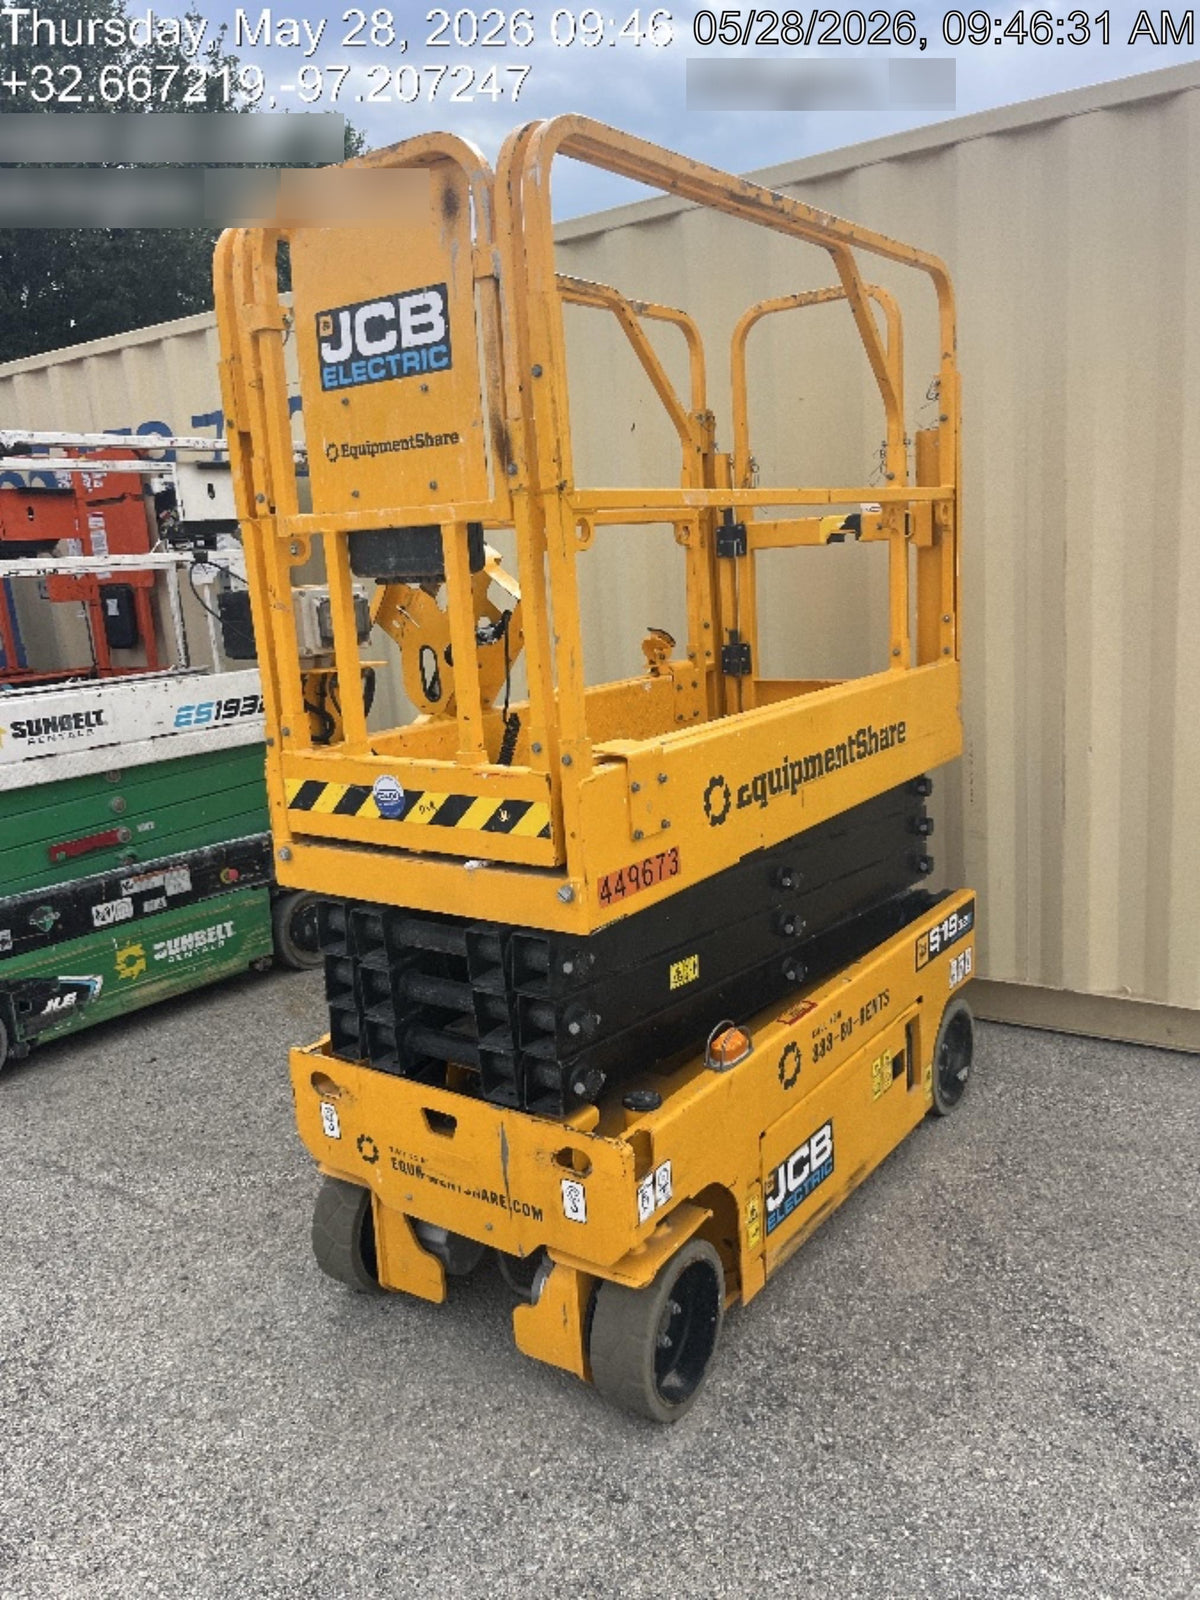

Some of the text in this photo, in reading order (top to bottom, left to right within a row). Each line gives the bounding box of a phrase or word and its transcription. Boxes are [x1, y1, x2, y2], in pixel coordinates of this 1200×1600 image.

[320, 290, 446, 364] JCB
[322, 344, 450, 389] ELECTRIC
[340, 431, 461, 460] EquipmentShare
[10, 708, 104, 739] SUNBELT
[600, 847, 679, 904] 449673
[153, 920, 235, 961] SUNBELT
[766, 1123, 834, 1213] JCB
[766, 1156, 833, 1236] ELECTRIC
